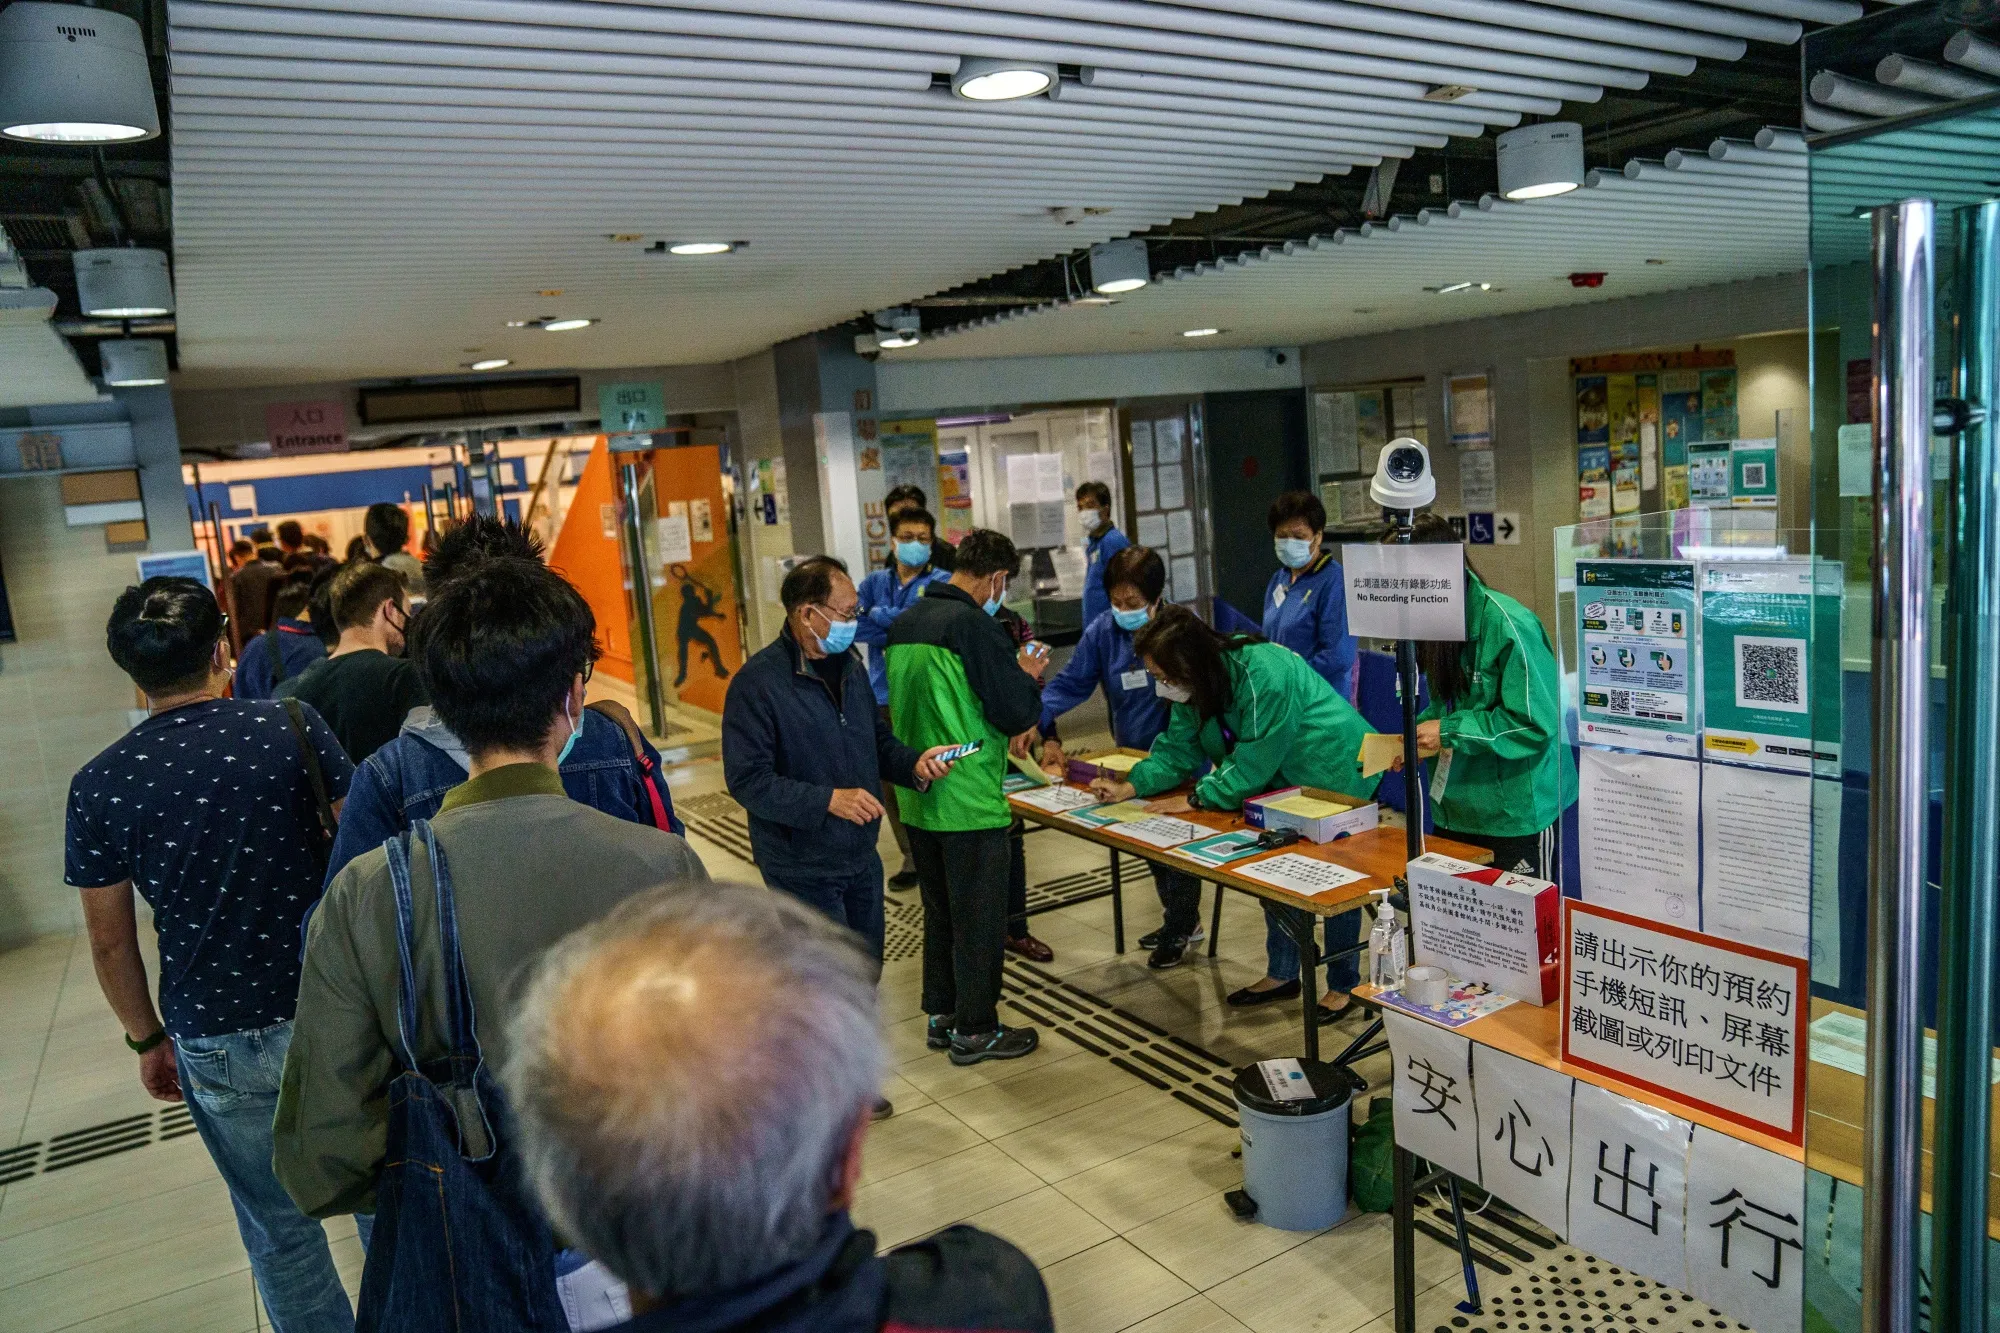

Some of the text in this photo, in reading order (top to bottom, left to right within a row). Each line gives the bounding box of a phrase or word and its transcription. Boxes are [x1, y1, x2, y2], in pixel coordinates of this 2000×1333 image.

[289, 408, 324, 426] 入口
[276, 433, 343, 449] Entrance
[1357, 593, 1449, 605] No Recording Function
[1614, 609, 1619, 617] 1
[1656, 611, 1662, 619] 2
[1573, 928, 1792, 1017] 請出示你的預約
[1573, 969, 1790, 1057] 手機短訊、屏幕
[1571, 1005, 1782, 1097] 截圖或列印文件
[1407, 1054, 1803, 1289] 安心出行
